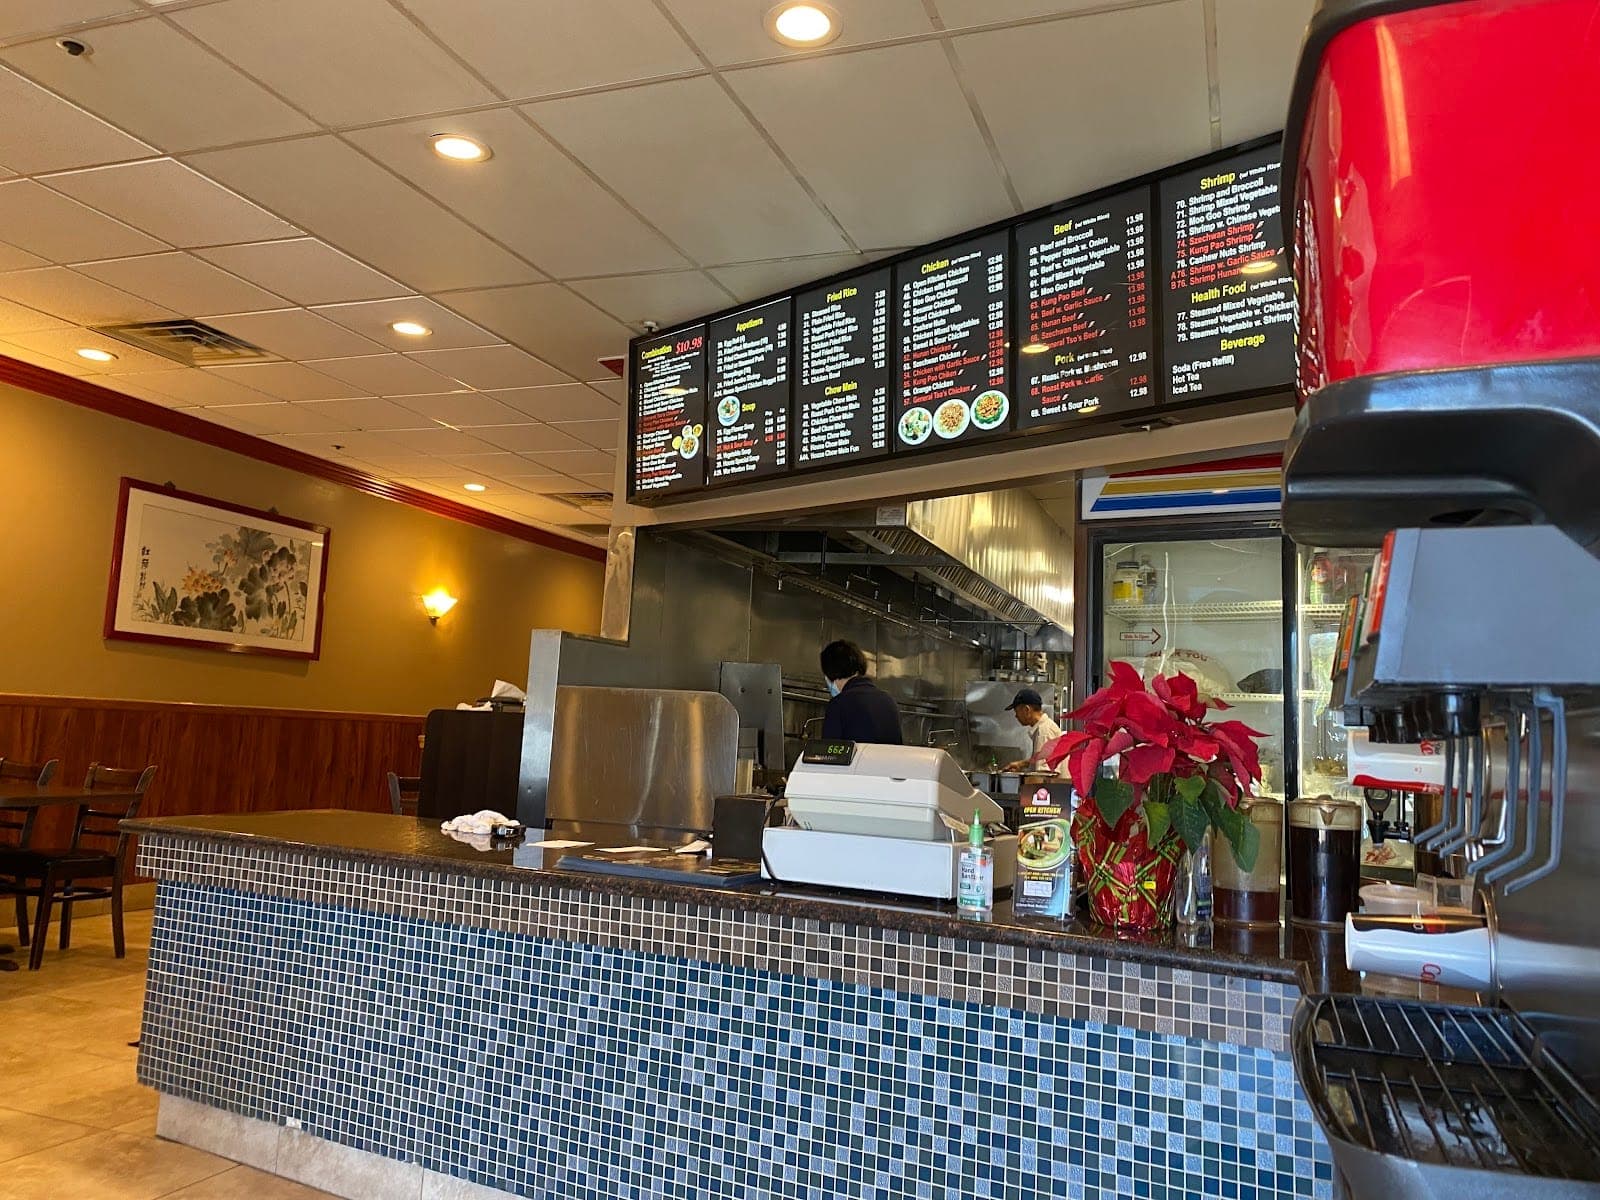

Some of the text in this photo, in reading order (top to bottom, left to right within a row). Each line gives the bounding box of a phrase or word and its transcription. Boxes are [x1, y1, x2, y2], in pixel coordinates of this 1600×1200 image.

[1200, 174, 1235, 190] Shrimp
[1176, 179, 1264, 209] 70. Shrimp and Broccoli
[1176, 185, 1278, 219] 71. Shrimp Mixed Vegetable
[1176, 203, 1250, 229] 72. Moo Goo Shrimp
[1054, 219, 1073, 235] Beef
[1126, 224, 1144, 236] 13.98
[1176, 230, 1187, 239] 73.
[1189, 223, 1215, 236] Shrimp
[1226, 213, 1257, 226] Chinese
[1176, 221, 1255, 248] 74. Szechwan Shrimp
[1040, 229, 1094, 252] Beef and Broccoli
[1127, 236, 1144, 247] 13.98
[1176, 233, 1253, 258] 75. Kung Pao Shrimp
[1040, 237, 1108, 263] Pepper Steak Onion
[1040, 244, 1120, 273] Beef Chinese Vegetable
[1127, 247, 1145, 259] 13.98
[1176, 241, 1266, 268] 76. Cashew Nuts Shrimp
[921, 259, 949, 273] Chicken
[1127, 259, 1145, 270] 13.98
[1189, 263, 1215, 275] Shrimp
[1227, 255, 1249, 266] Garlic
[1251, 250, 1275, 261] Sauce
[913, 267, 970, 288] Open Chicken
[1029, 279, 1039, 288] 61.
[1074, 260, 1105, 275] Vegetable
[1189, 273, 1216, 285] Shrimp
[936, 288, 958, 299] Chicken
[1030, 276, 1084, 298] 62. Moo Goo Beef
[1191, 281, 1246, 303] Health Food
[827, 289, 857, 303] Fried Rice
[1030, 288, 1086, 310] 63. Kung Pao Beef
[1030, 296, 1103, 320] 64. Beef Garlic Sauce
[1128, 306, 1145, 316] 13.98
[1177, 292, 1285, 321] 77. Steamed Mixed Vegetable
[1030, 312, 1076, 331] 65. Hunan Beef
[1128, 317, 1146, 328] 13.98
[1177, 323, 1188, 332] 78.
[1190, 315, 1219, 329] Steamed
[1220, 309, 1253, 323] Vegetable
[1177, 333, 1188, 342] 79.
[1190, 326, 1219, 339] Steamed
[1220, 320, 1253, 333] Vegetable
[1263, 312, 1292, 324] Shrimp
[1041, 326, 1072, 339] Szechwan
[1073, 321, 1088, 331] Beef
[1066, 329, 1098, 345] Tso's Beef
[676, 337, 702, 353] $10.98
[1220, 334, 1265, 351] Beverage
[939, 351, 961, 361] Chicken
[1055, 351, 1075, 366] Pork
[1128, 352, 1147, 362] 12.98
[1172, 355, 1235, 374] Soda (Free Refill)
[913, 356, 980, 376] Chicken Garlic Sauce
[932, 380, 954, 389] Chicken
[1031, 376, 1040, 385] 67.
[1042, 371, 1060, 382] Roast
[1060, 368, 1074, 378] Pork
[1042, 382, 1059, 393] Roast
[1060, 379, 1075, 389] Pork
[1085, 373, 1104, 384] Garlic
[1130, 374, 1147, 385] 12.98
[1173, 373, 1199, 384] Hot Tea
[825, 382, 857, 395] Chow Mein
[913, 385, 970, 403] General Chicken
[1130, 386, 1148, 397] 12.98
[1173, 382, 1202, 394] Iced Tea
[742, 404, 756, 412] Soup
[1041, 395, 1061, 404] Sauce
[1042, 404, 1060, 415] Sweet
[1068, 402, 1083, 410] Sour
[1084, 397, 1099, 407] Pork
[1186, 652, 1208, 662] YOU
